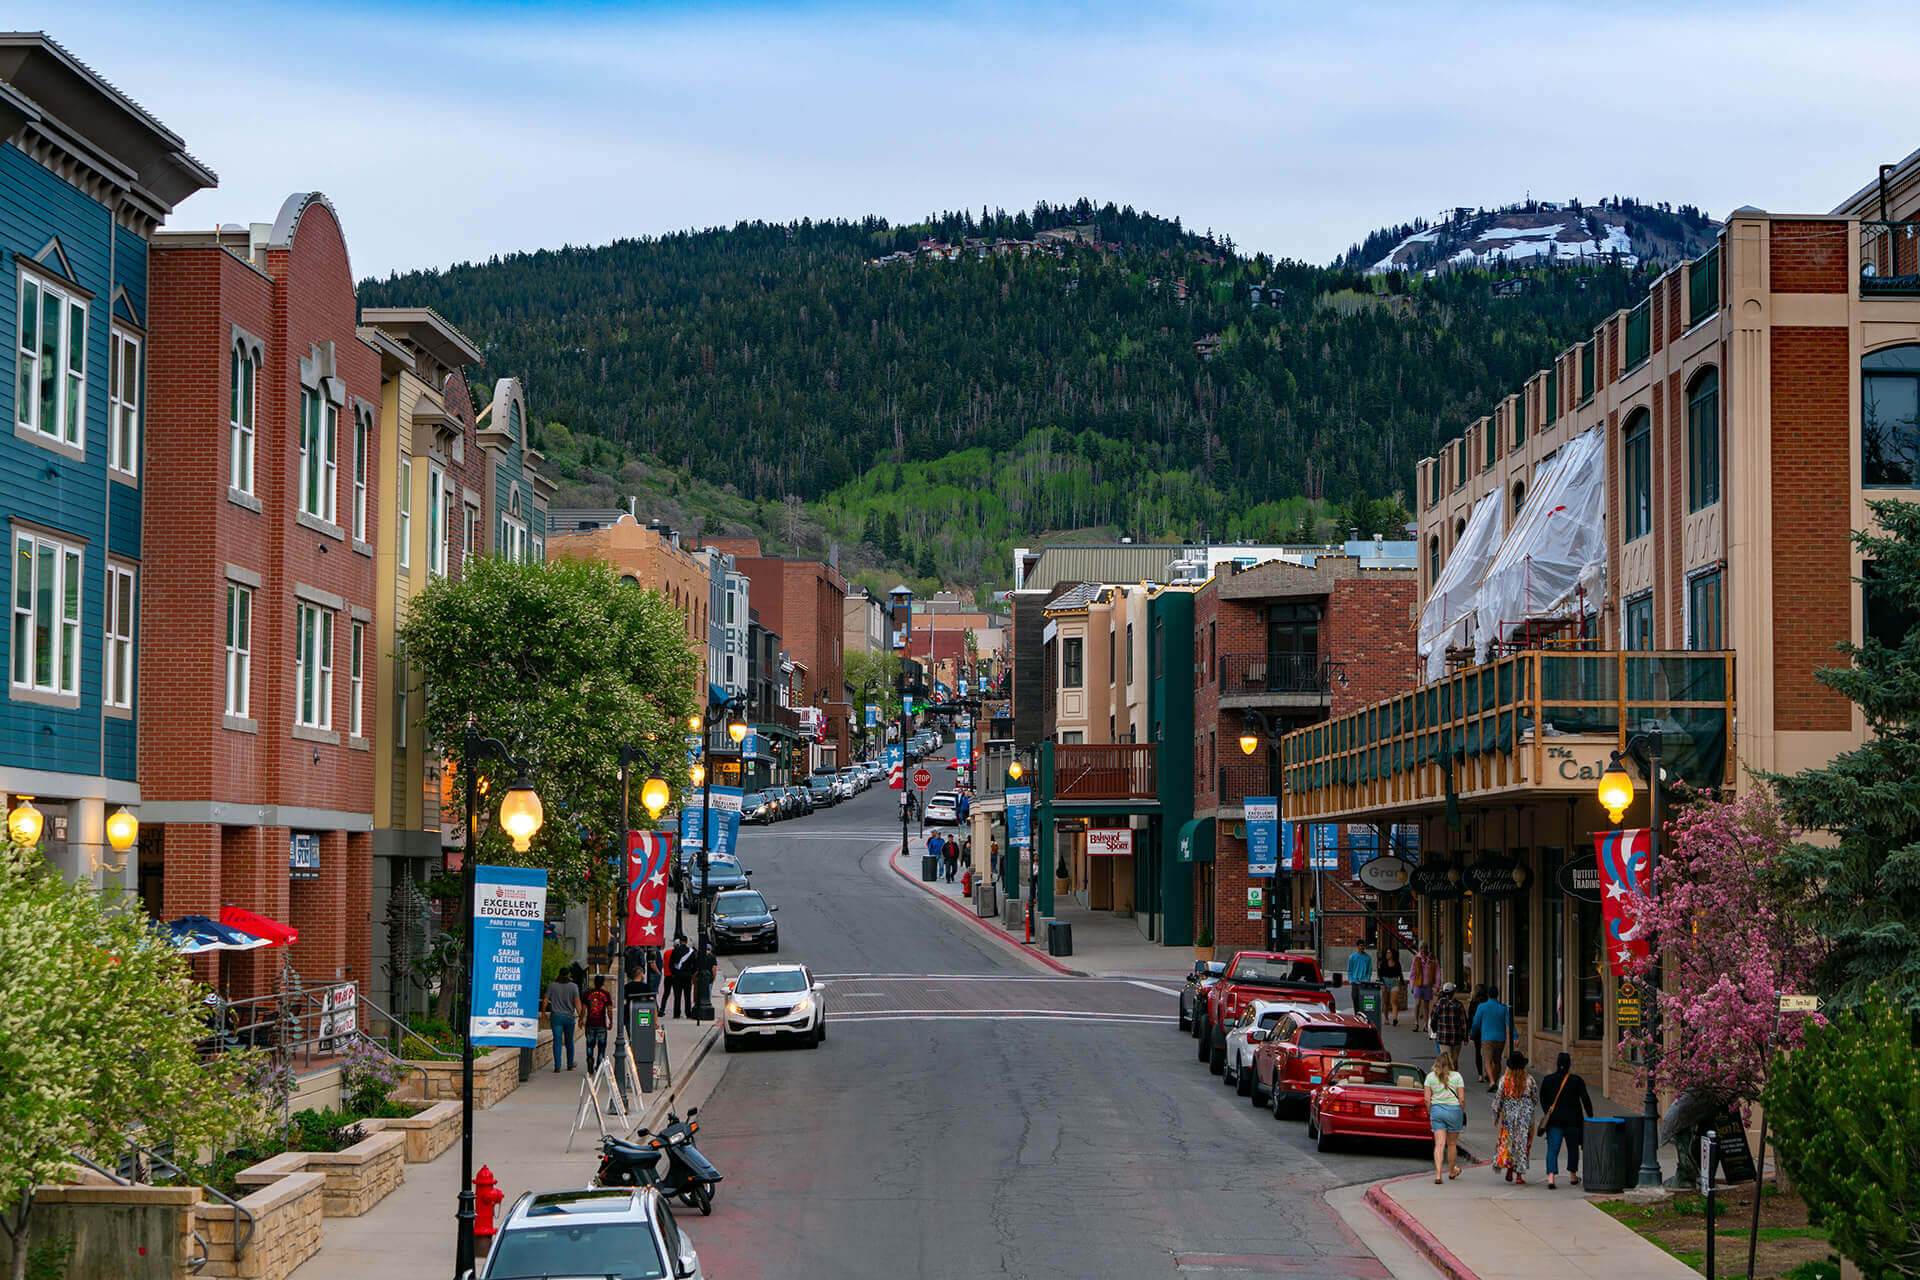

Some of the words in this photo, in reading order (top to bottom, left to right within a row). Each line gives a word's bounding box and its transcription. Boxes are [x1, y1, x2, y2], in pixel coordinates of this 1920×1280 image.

[1547, 746, 1573, 758] The
[1558, 758, 1603, 780] Cal
[914, 774, 930, 782] STOP
[1572, 868, 1600, 880] OUTFITT
[1573, 879, 1601, 889] TRADING
[483, 898, 538, 909] EXCELLENT
[480, 907, 540, 918] EDUCATORS
[501, 931, 518, 939] KYLE
[501, 938, 517, 946] FISH
[497, 948, 520, 956] SARAH
[492, 955, 525, 964] FLETCHER
[495, 966, 521, 974] JOSHUA
[494, 973, 521, 981] FLICKER
[492, 983, 522, 991] JENNIFER
[497, 990, 517, 998] FRINK
[494, 1000, 518, 1009] ALISON
[487, 1007, 525, 1016] GALLAGHER
